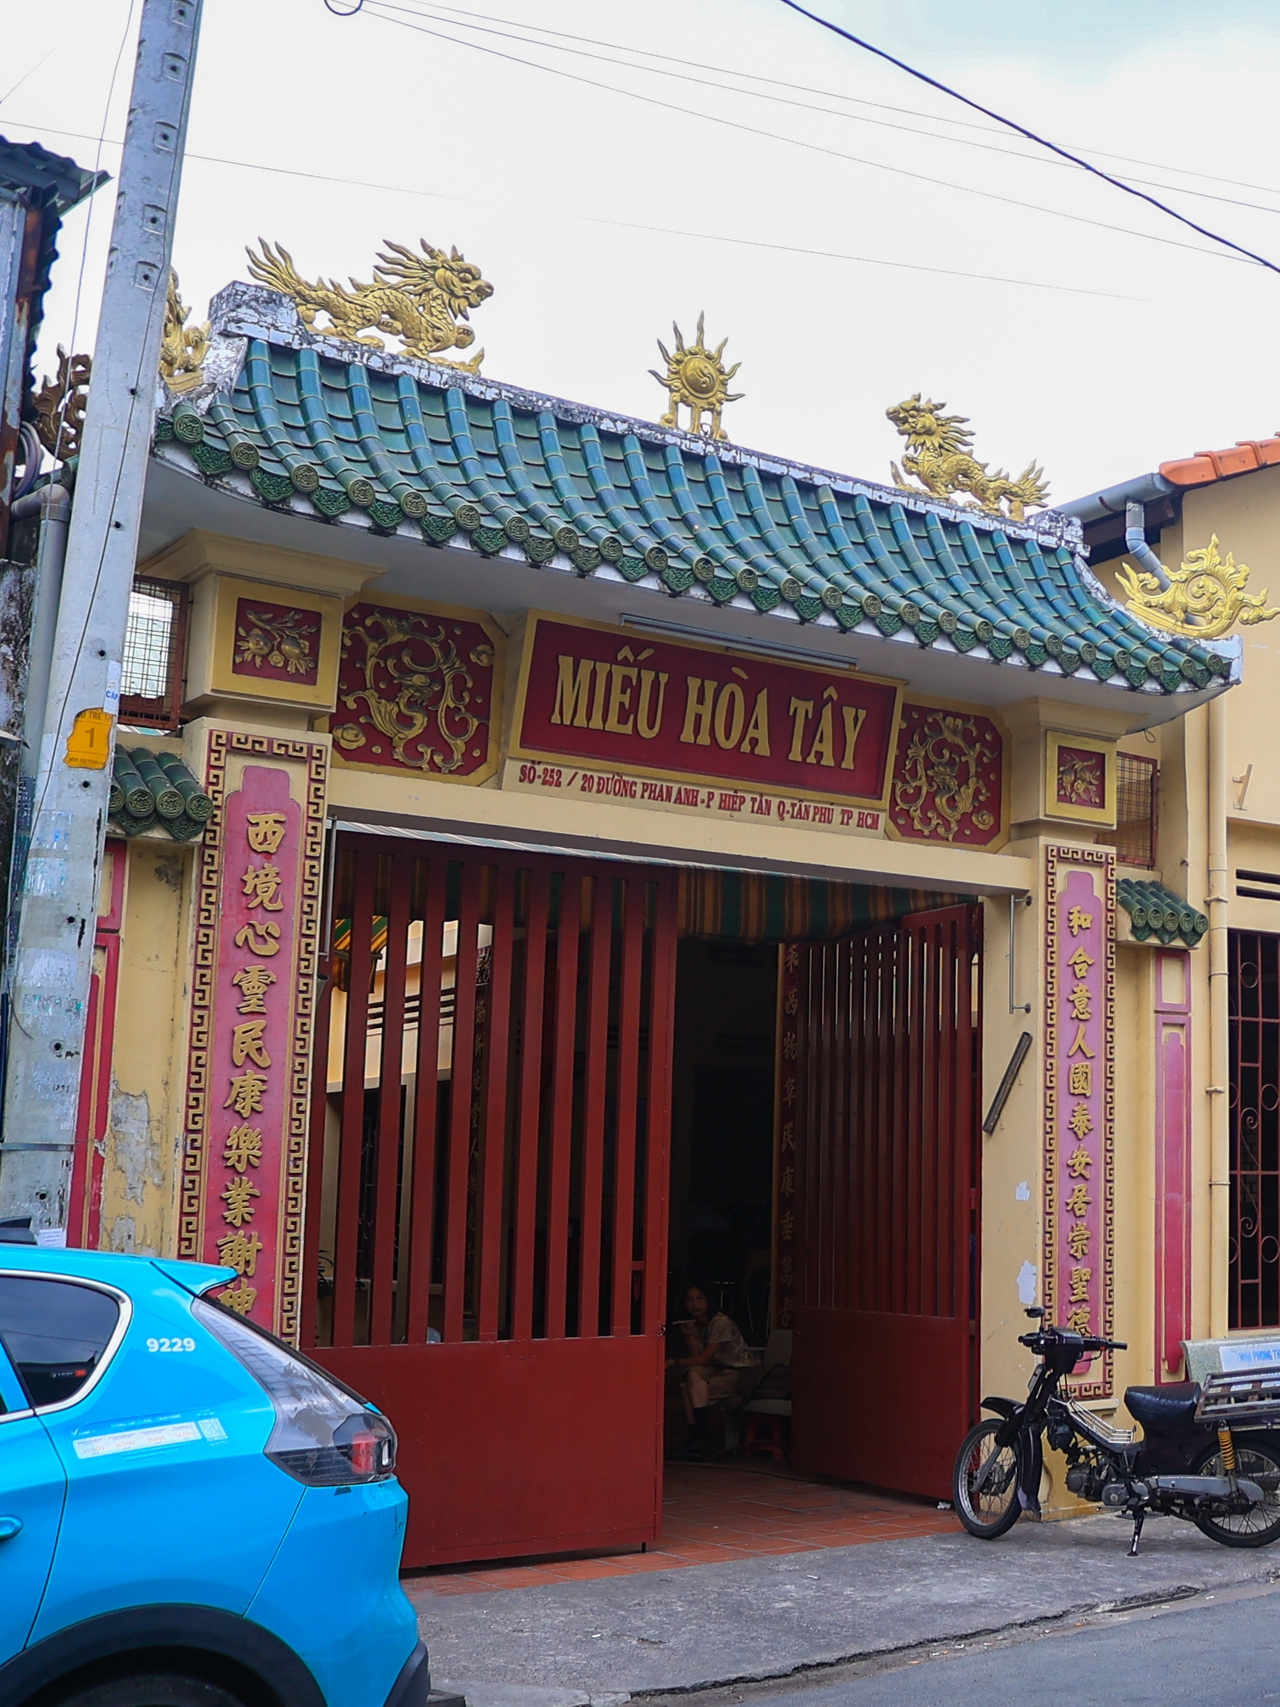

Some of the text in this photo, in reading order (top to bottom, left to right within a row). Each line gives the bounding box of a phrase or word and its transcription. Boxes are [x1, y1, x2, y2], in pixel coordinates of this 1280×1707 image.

[550, 644, 867, 770] MIẾU HÒA TÂY
[640, 781, 673, 804] PHAN
[811, 802, 835, 825] PHÚ
[839, 808, 854, 826] TP
[855, 811, 881, 831] HCM
[146, 1337, 196, 1352] 9229
